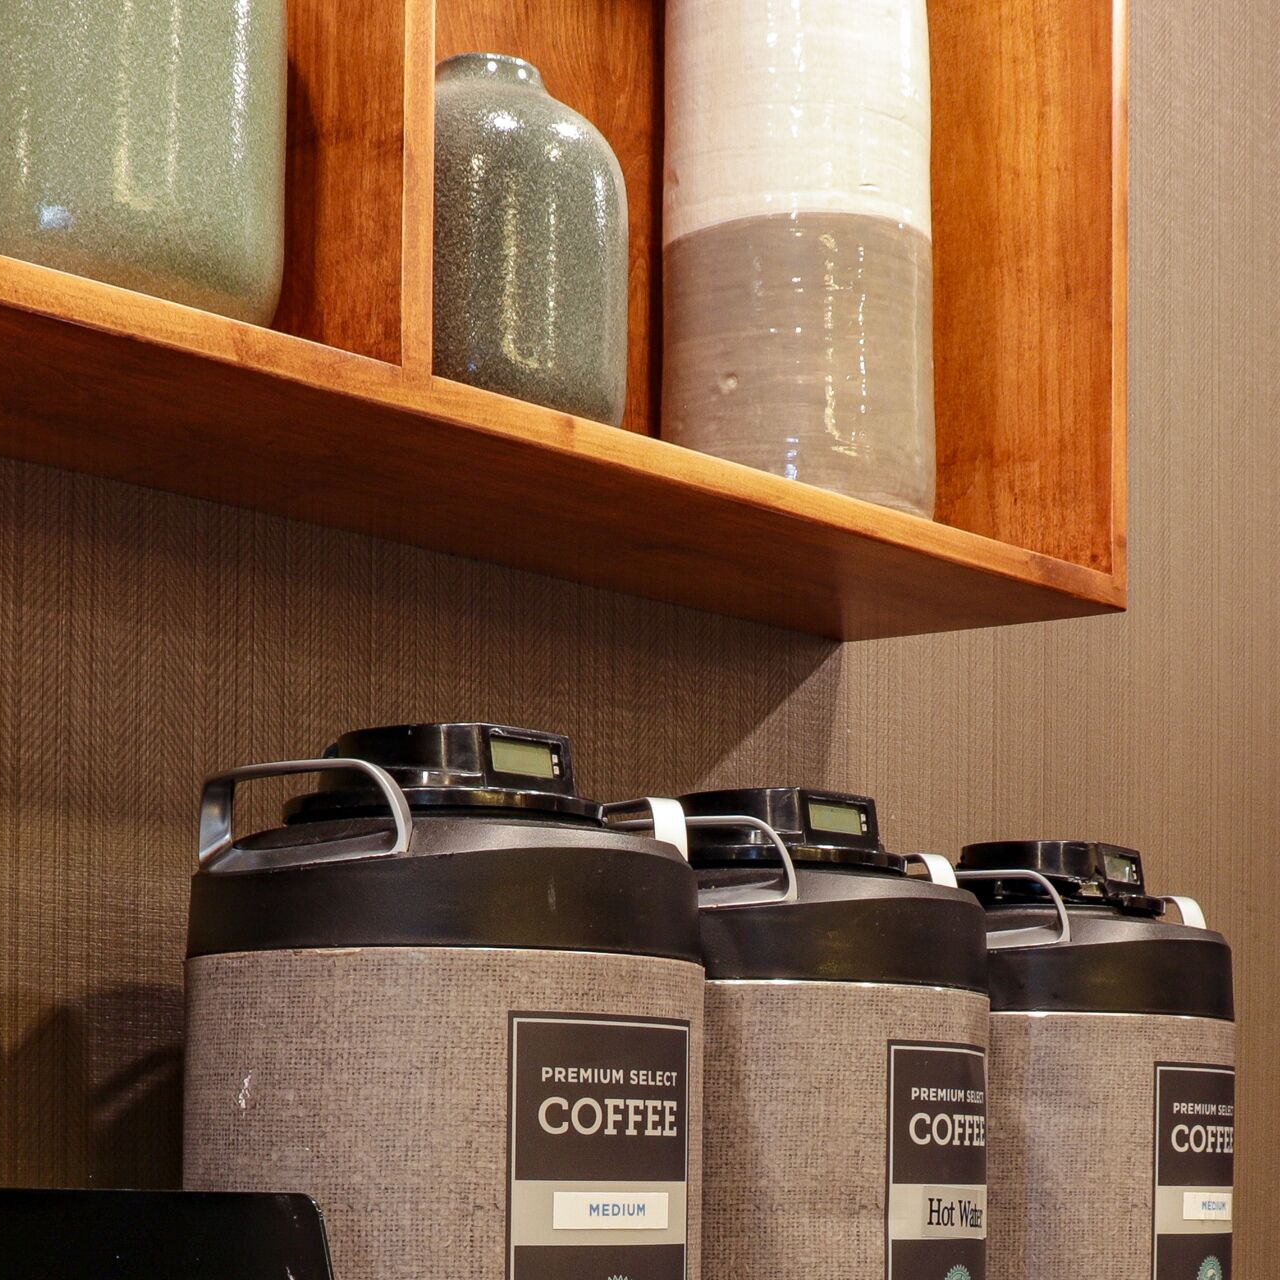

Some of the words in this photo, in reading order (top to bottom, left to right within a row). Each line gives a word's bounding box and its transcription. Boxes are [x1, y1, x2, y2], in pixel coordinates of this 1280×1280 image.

[541, 1067, 624, 1084] PREMIUM
[629, 1069, 678, 1087] SELECT
[911, 1087, 965, 1102] PREMIUM
[966, 1090, 984, 1104] SELECT
[538, 1096, 678, 1137] COFFEE
[1173, 1102, 1217, 1116] PREMIUM
[909, 1112, 985, 1147] COFFEE
[588, 1203, 646, 1217] MEDIUM
[927, 1198, 955, 1227] Hot
